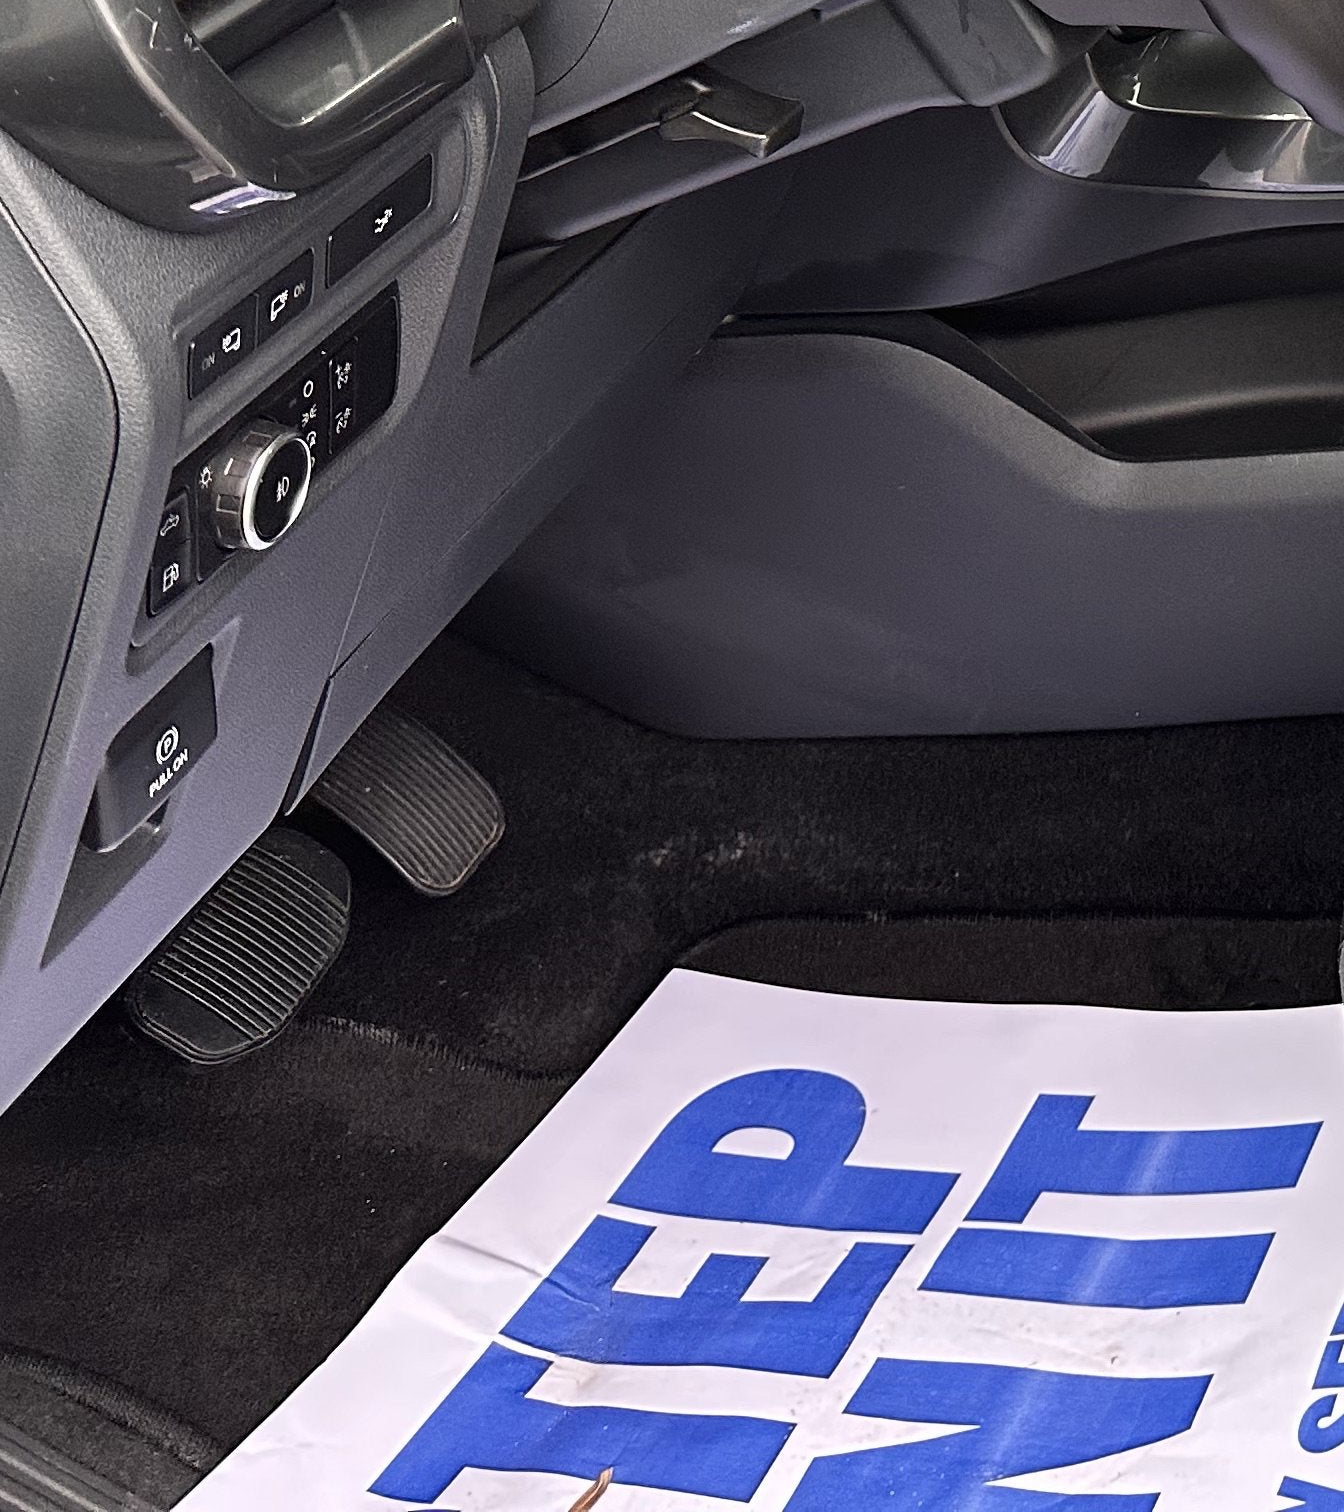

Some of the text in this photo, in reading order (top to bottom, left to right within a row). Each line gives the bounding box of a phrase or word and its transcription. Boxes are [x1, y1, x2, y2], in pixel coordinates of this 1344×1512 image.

[149, 748, 189, 798] PULL ON
[366, 1067, 961, 1512] TEP
